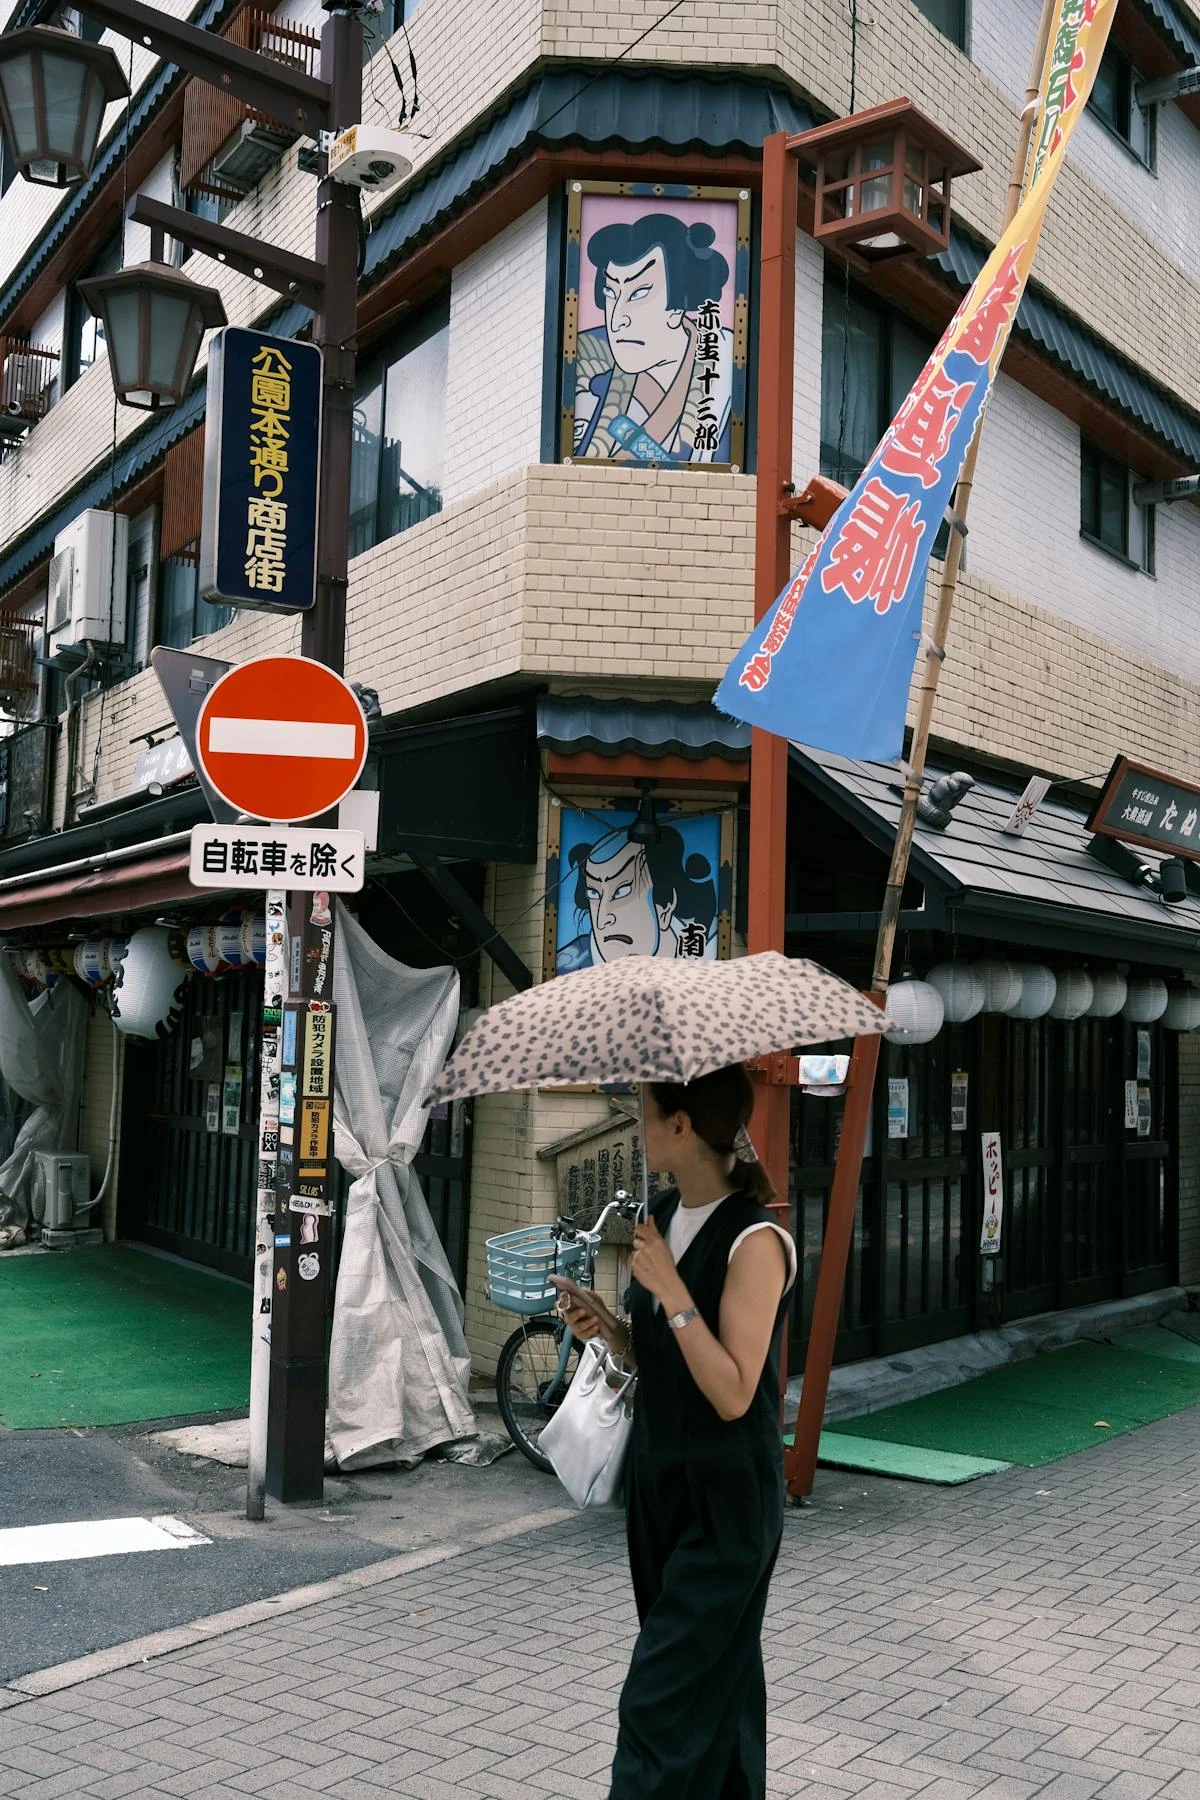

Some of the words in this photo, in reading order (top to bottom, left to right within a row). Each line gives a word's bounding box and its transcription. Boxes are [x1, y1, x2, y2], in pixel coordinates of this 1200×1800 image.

[243, 345, 293, 594] 公園本通り商店街
[1121, 803, 1154, 827] 大衆酒場
[1159, 800, 1200, 836] たぬ
[202, 839, 356, 878] 自転車を除く
[679, 922, 706, 959] 南
[309, 1014, 327, 1094] 防犯カメラ設置地域
[309, 1111, 320, 1158] 防犯カメラ作動中
[986, 1140, 1000, 1215] ホッピー
